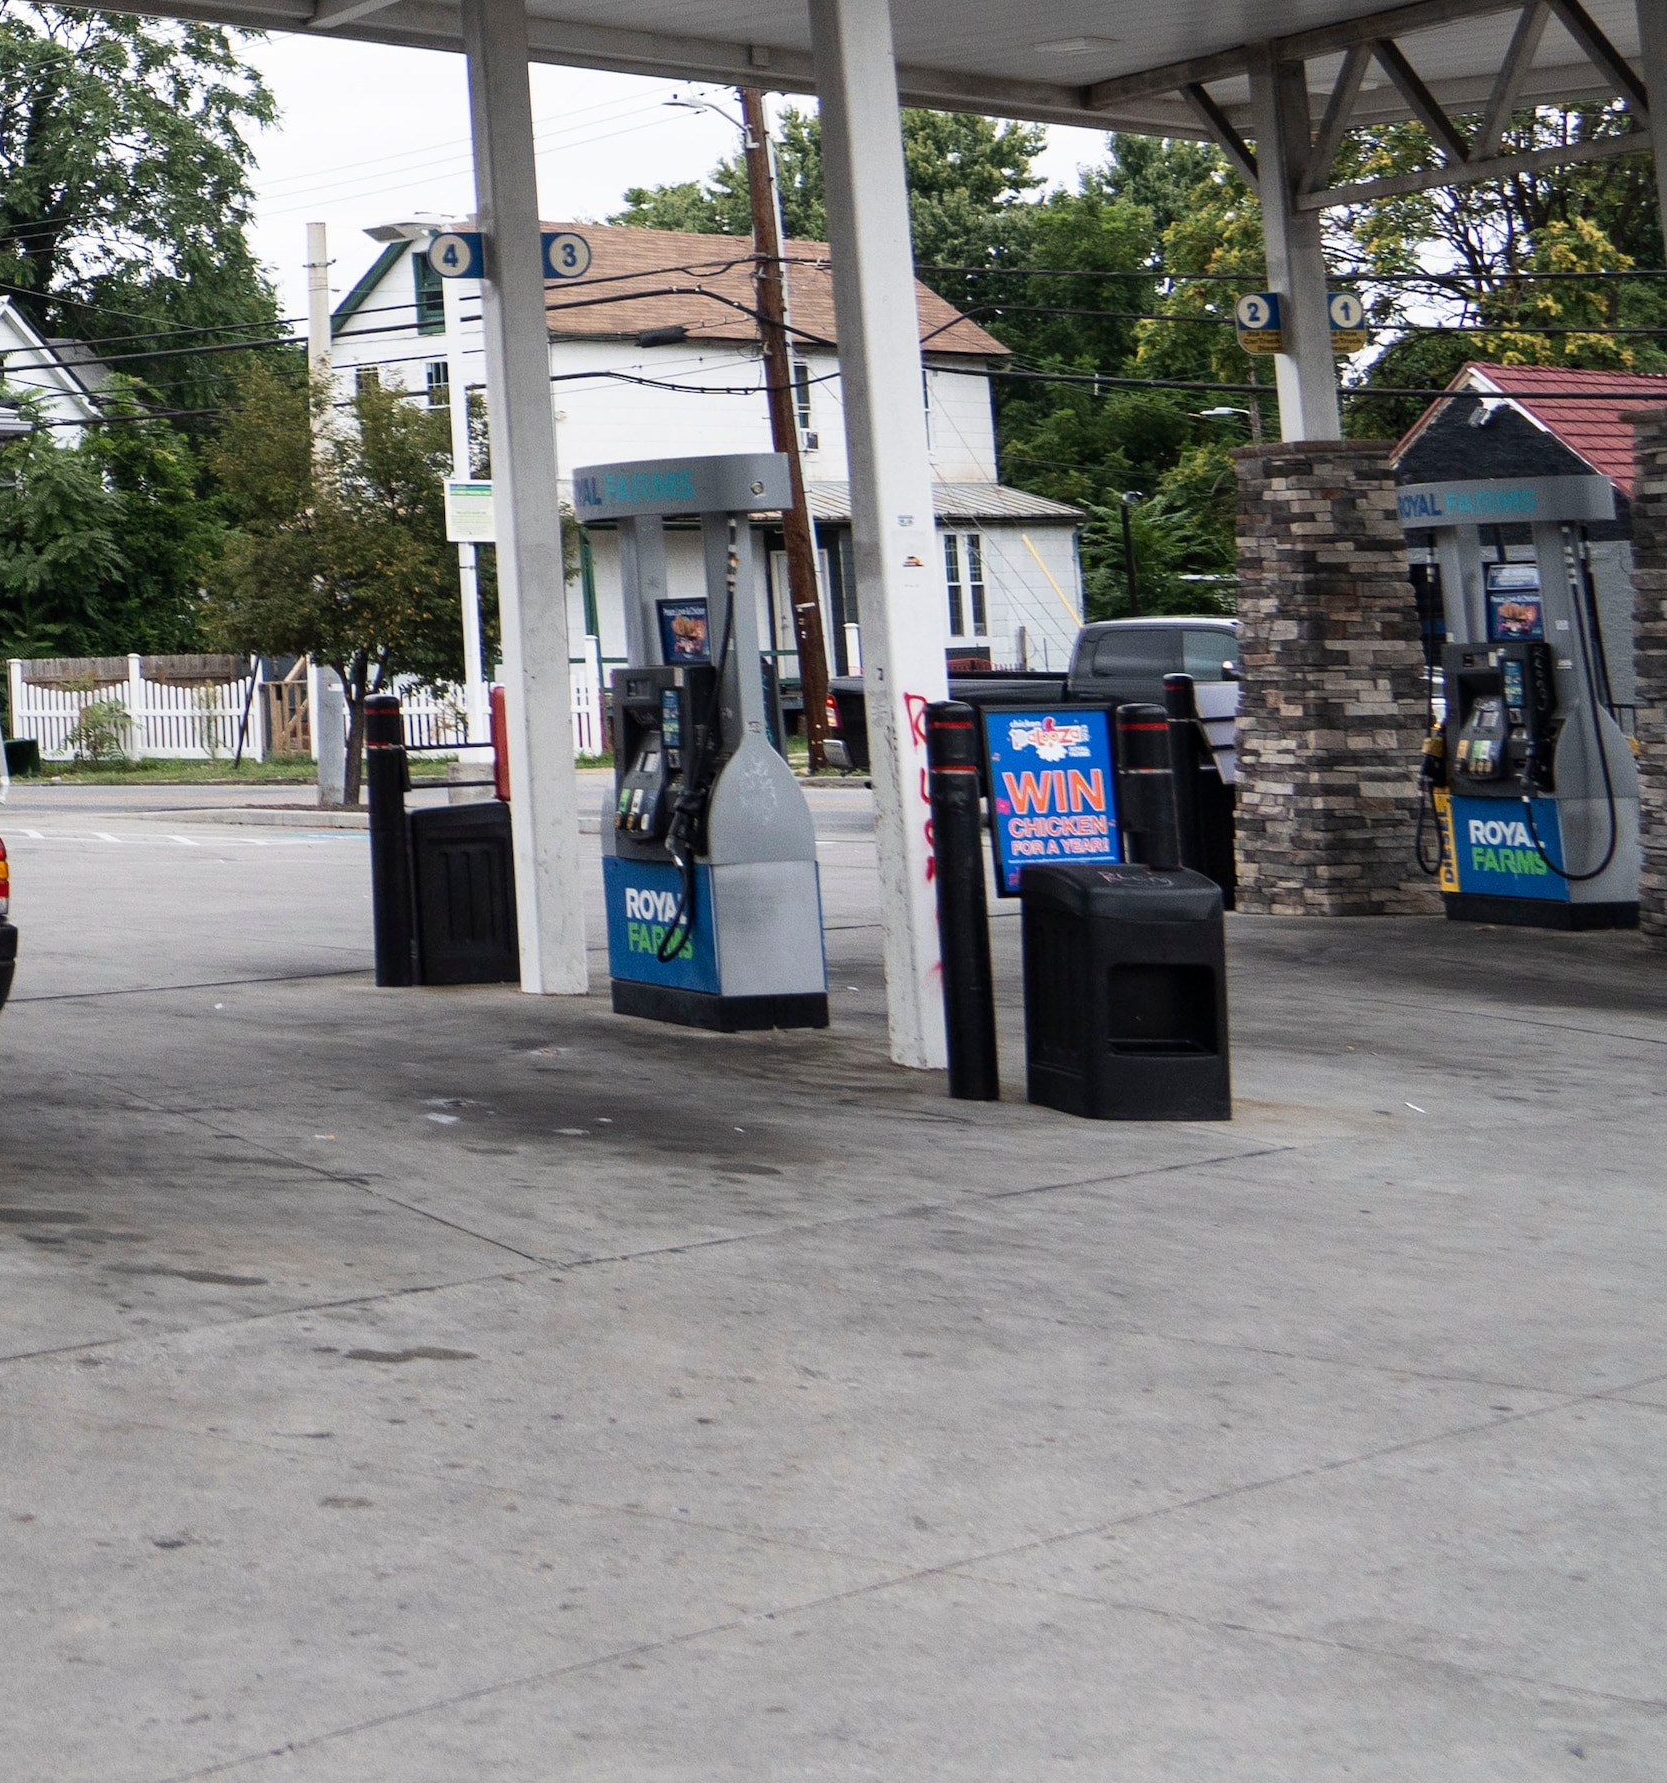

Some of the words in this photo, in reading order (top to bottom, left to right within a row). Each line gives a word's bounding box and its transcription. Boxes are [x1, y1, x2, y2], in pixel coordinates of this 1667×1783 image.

[442, 243, 459, 267] 4
[561, 243, 578, 267] 3
[1247, 302, 1260, 322] 2
[1339, 301, 1351, 321] 1
[604, 469, 695, 504] FARMS
[1444, 488, 1537, 514] FARMS
[1002, 768, 1106, 814] WIN
[1008, 815, 1108, 838] CHICKEN
[1011, 840, 1045, 856] FOR
[1046, 839, 1060, 854] A
[1061, 837, 1110, 854] YEAR!
[1471, 847, 1548, 876] FARMS
